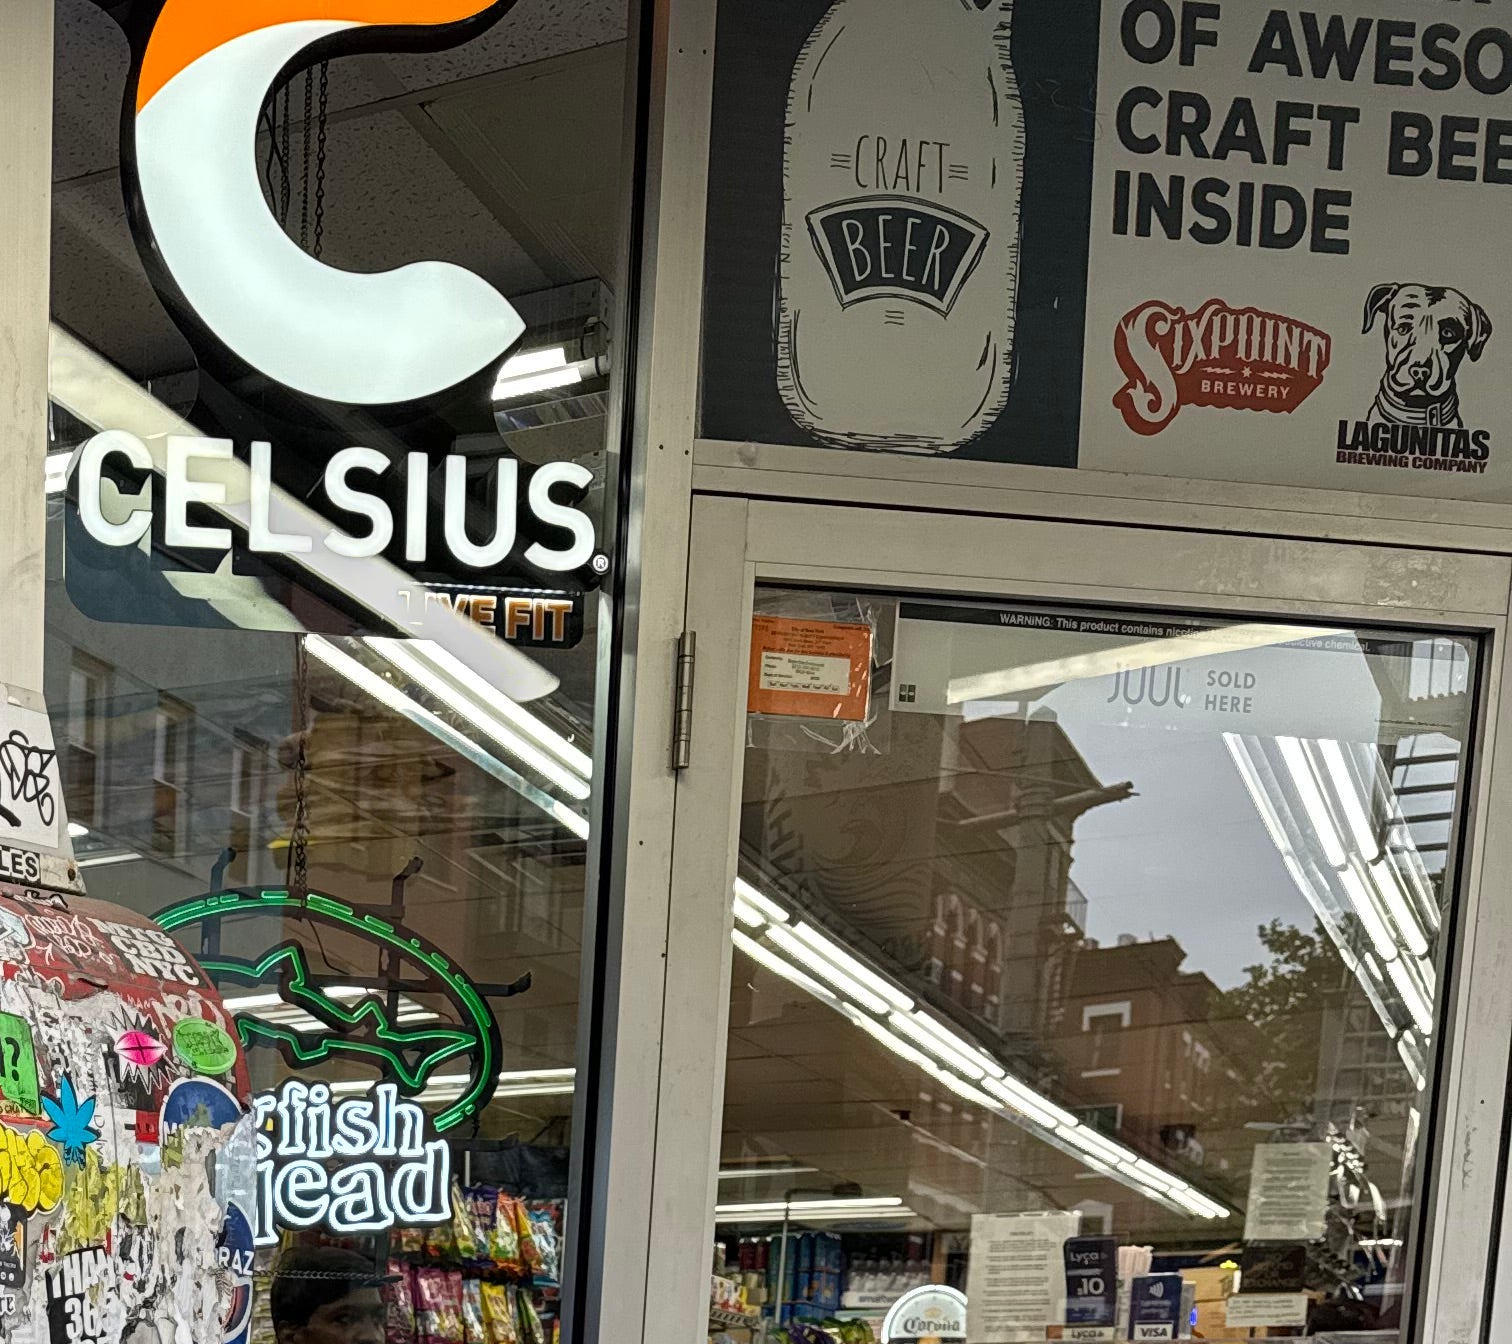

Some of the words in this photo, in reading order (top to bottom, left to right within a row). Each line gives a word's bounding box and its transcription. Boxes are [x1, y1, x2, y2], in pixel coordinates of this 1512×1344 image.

[1121, 0, 1219, 66] OF
[1116, 86, 1360, 171] CRAFT
[855, 134, 949, 193] CRAFT
[1113, 171, 1351, 256] INSIDE
[844, 214, 952, 292] BEER
[1201, 380, 1290, 399] BREWERY
[1337, 420, 1490, 460] LAGUNITAS
[1336, 451, 1409, 469] BREWING
[1412, 456, 1487, 474] COMPANY
[505, 598, 573, 641] FIT
[1000, 612, 1055, 629] WARNING:
[1056, 617, 1077, 631] This
[1079, 620, 1119, 636] product
[1121, 622, 1164, 637] contains
[1207, 669, 1256, 690] SOLD
[1205, 694, 1252, 714] HERE
[124, 953, 200, 986] NYC
